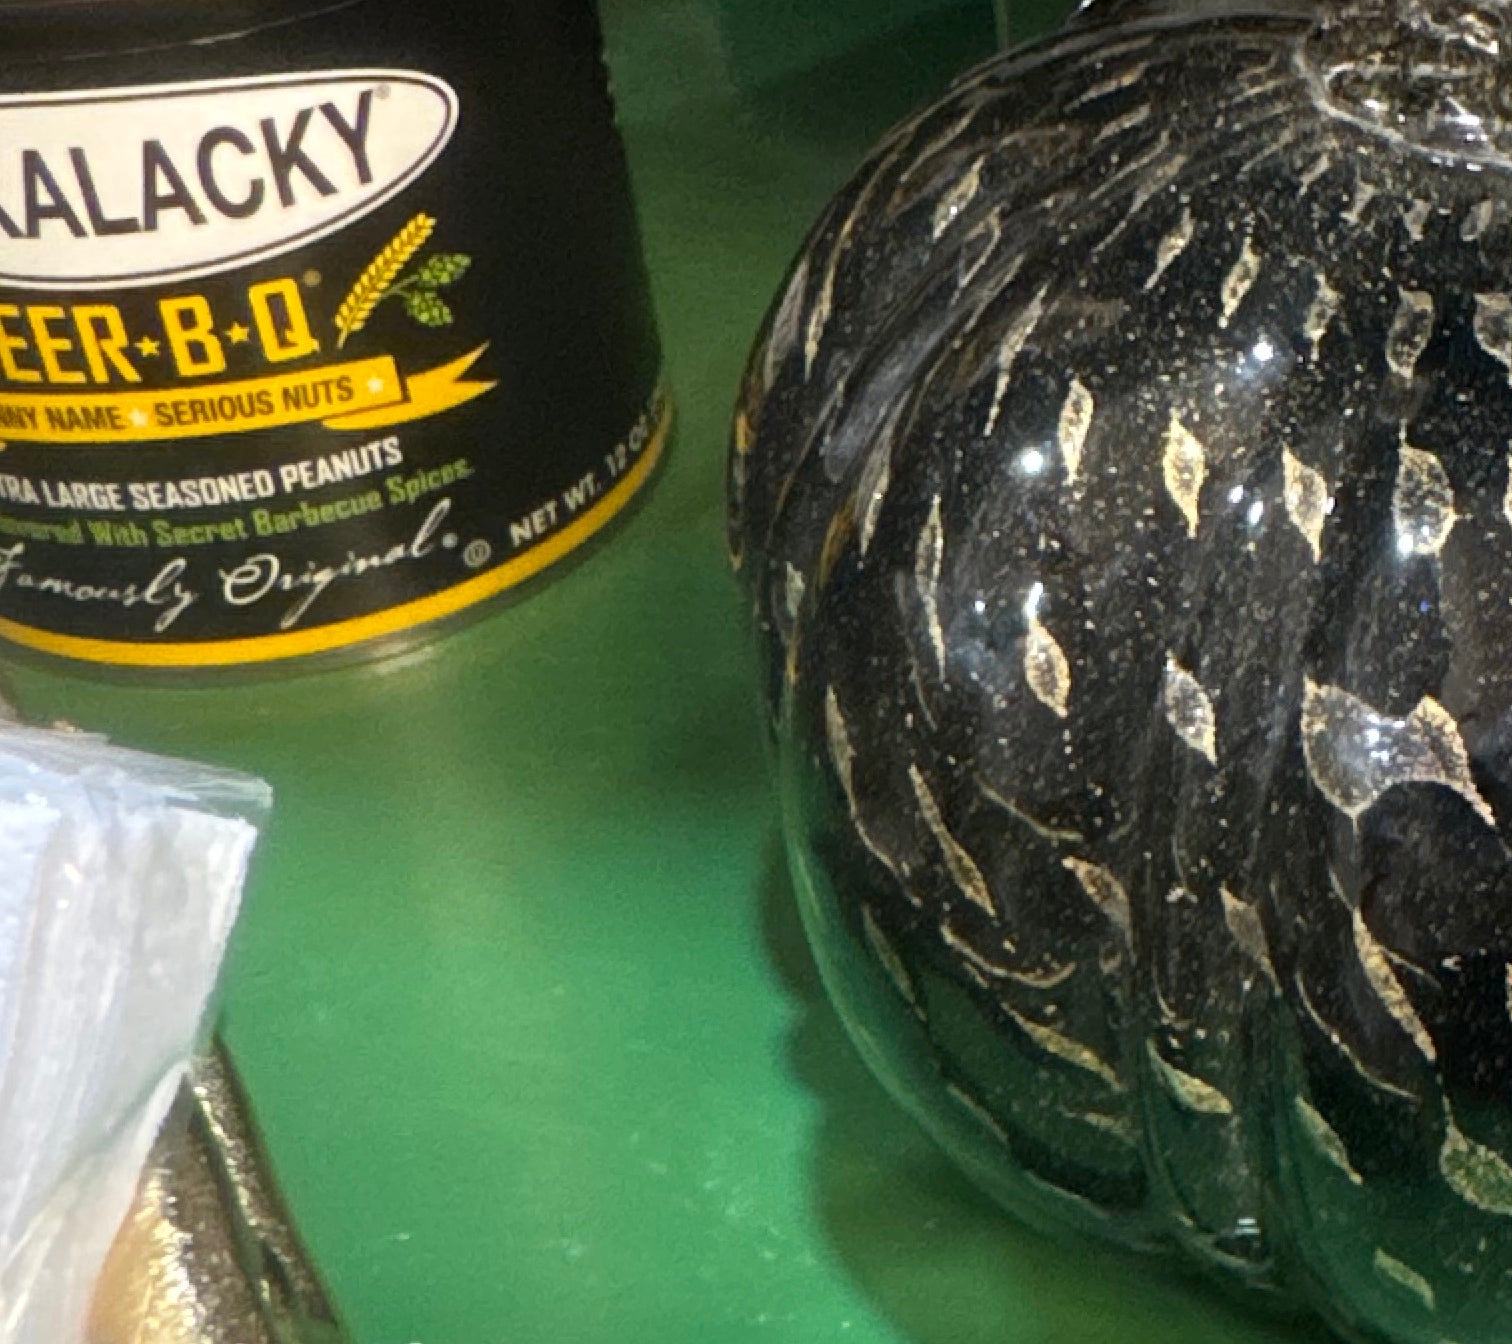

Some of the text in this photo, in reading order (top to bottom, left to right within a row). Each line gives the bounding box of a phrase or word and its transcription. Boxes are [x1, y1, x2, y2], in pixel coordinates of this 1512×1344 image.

[46, 405, 126, 432] NAME
[153, 390, 274, 427] SERIOUS
[282, 375, 355, 412] NUTS
[41, 478, 126, 511] LARGE
[128, 469, 276, 511] SEASONED
[279, 434, 404, 493] PEANUTS
[252, 490, 384, 537] Barbecue
[508, 498, 560, 549] NET
[218, 496, 452, 630] Original
